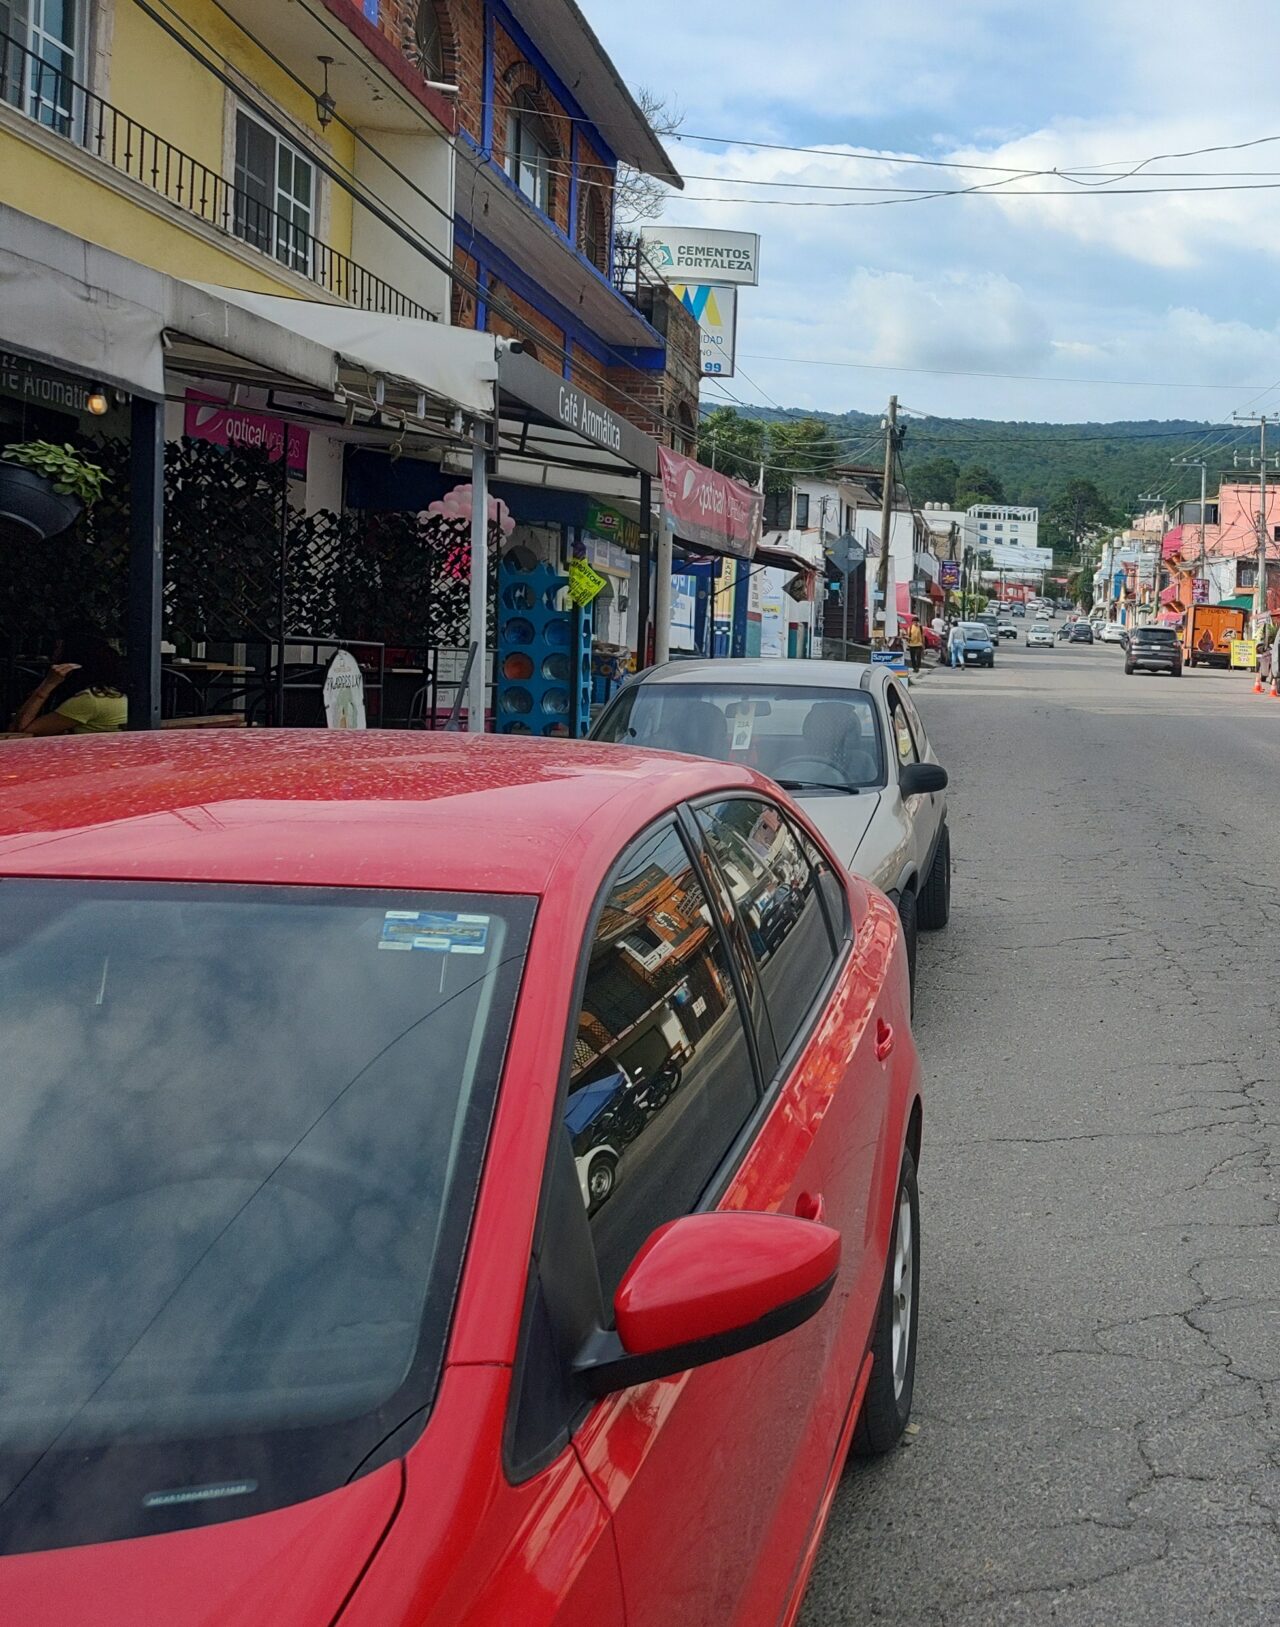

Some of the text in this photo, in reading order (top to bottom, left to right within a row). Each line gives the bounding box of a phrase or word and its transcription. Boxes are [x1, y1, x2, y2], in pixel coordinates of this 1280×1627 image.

[678, 246, 750, 259] CEMENTOS
[677, 257, 752, 271] FORTALEZA
[704, 362, 722, 372] 99
[559, 386, 621, 451] Café Aromática
[872, 653, 892, 662] Sayer
